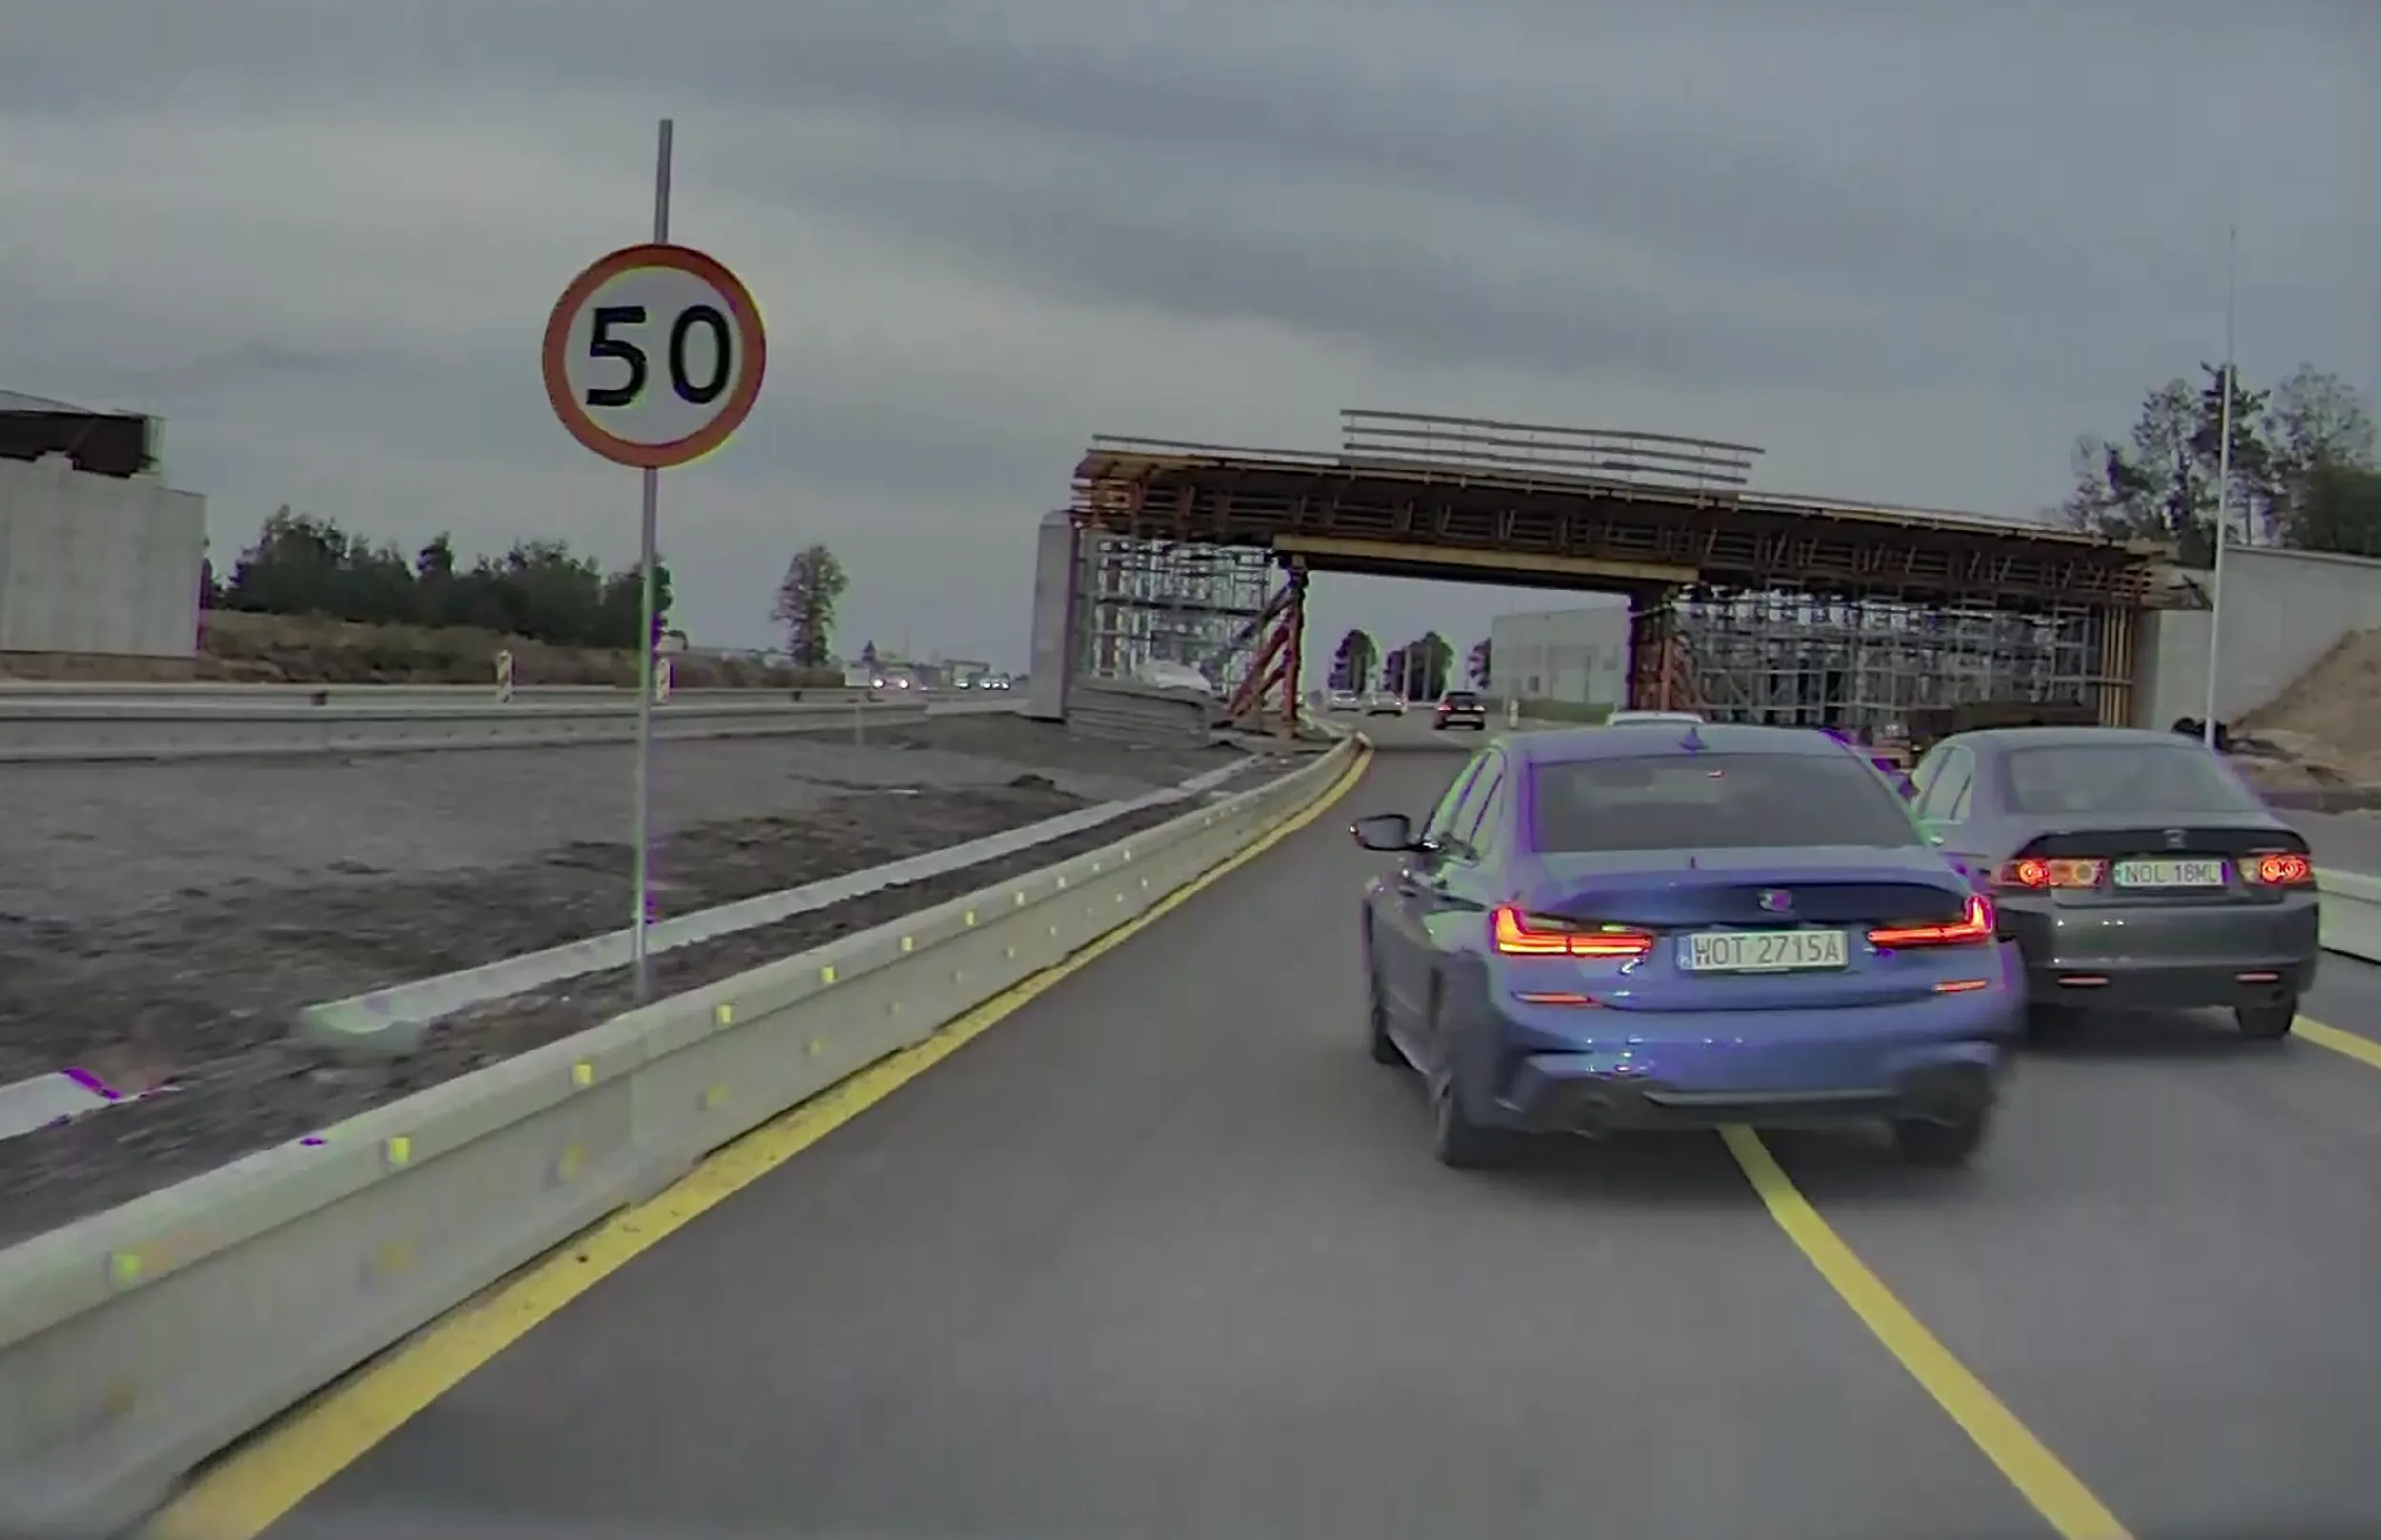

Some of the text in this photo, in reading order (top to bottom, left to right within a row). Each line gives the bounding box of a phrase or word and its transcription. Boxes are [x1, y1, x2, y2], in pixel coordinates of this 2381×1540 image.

[586, 305, 731, 406] 50
[2125, 863, 2166, 884] NOL
[1694, 936, 1747, 965] WOT
[1757, 934, 1840, 964] 2715A
